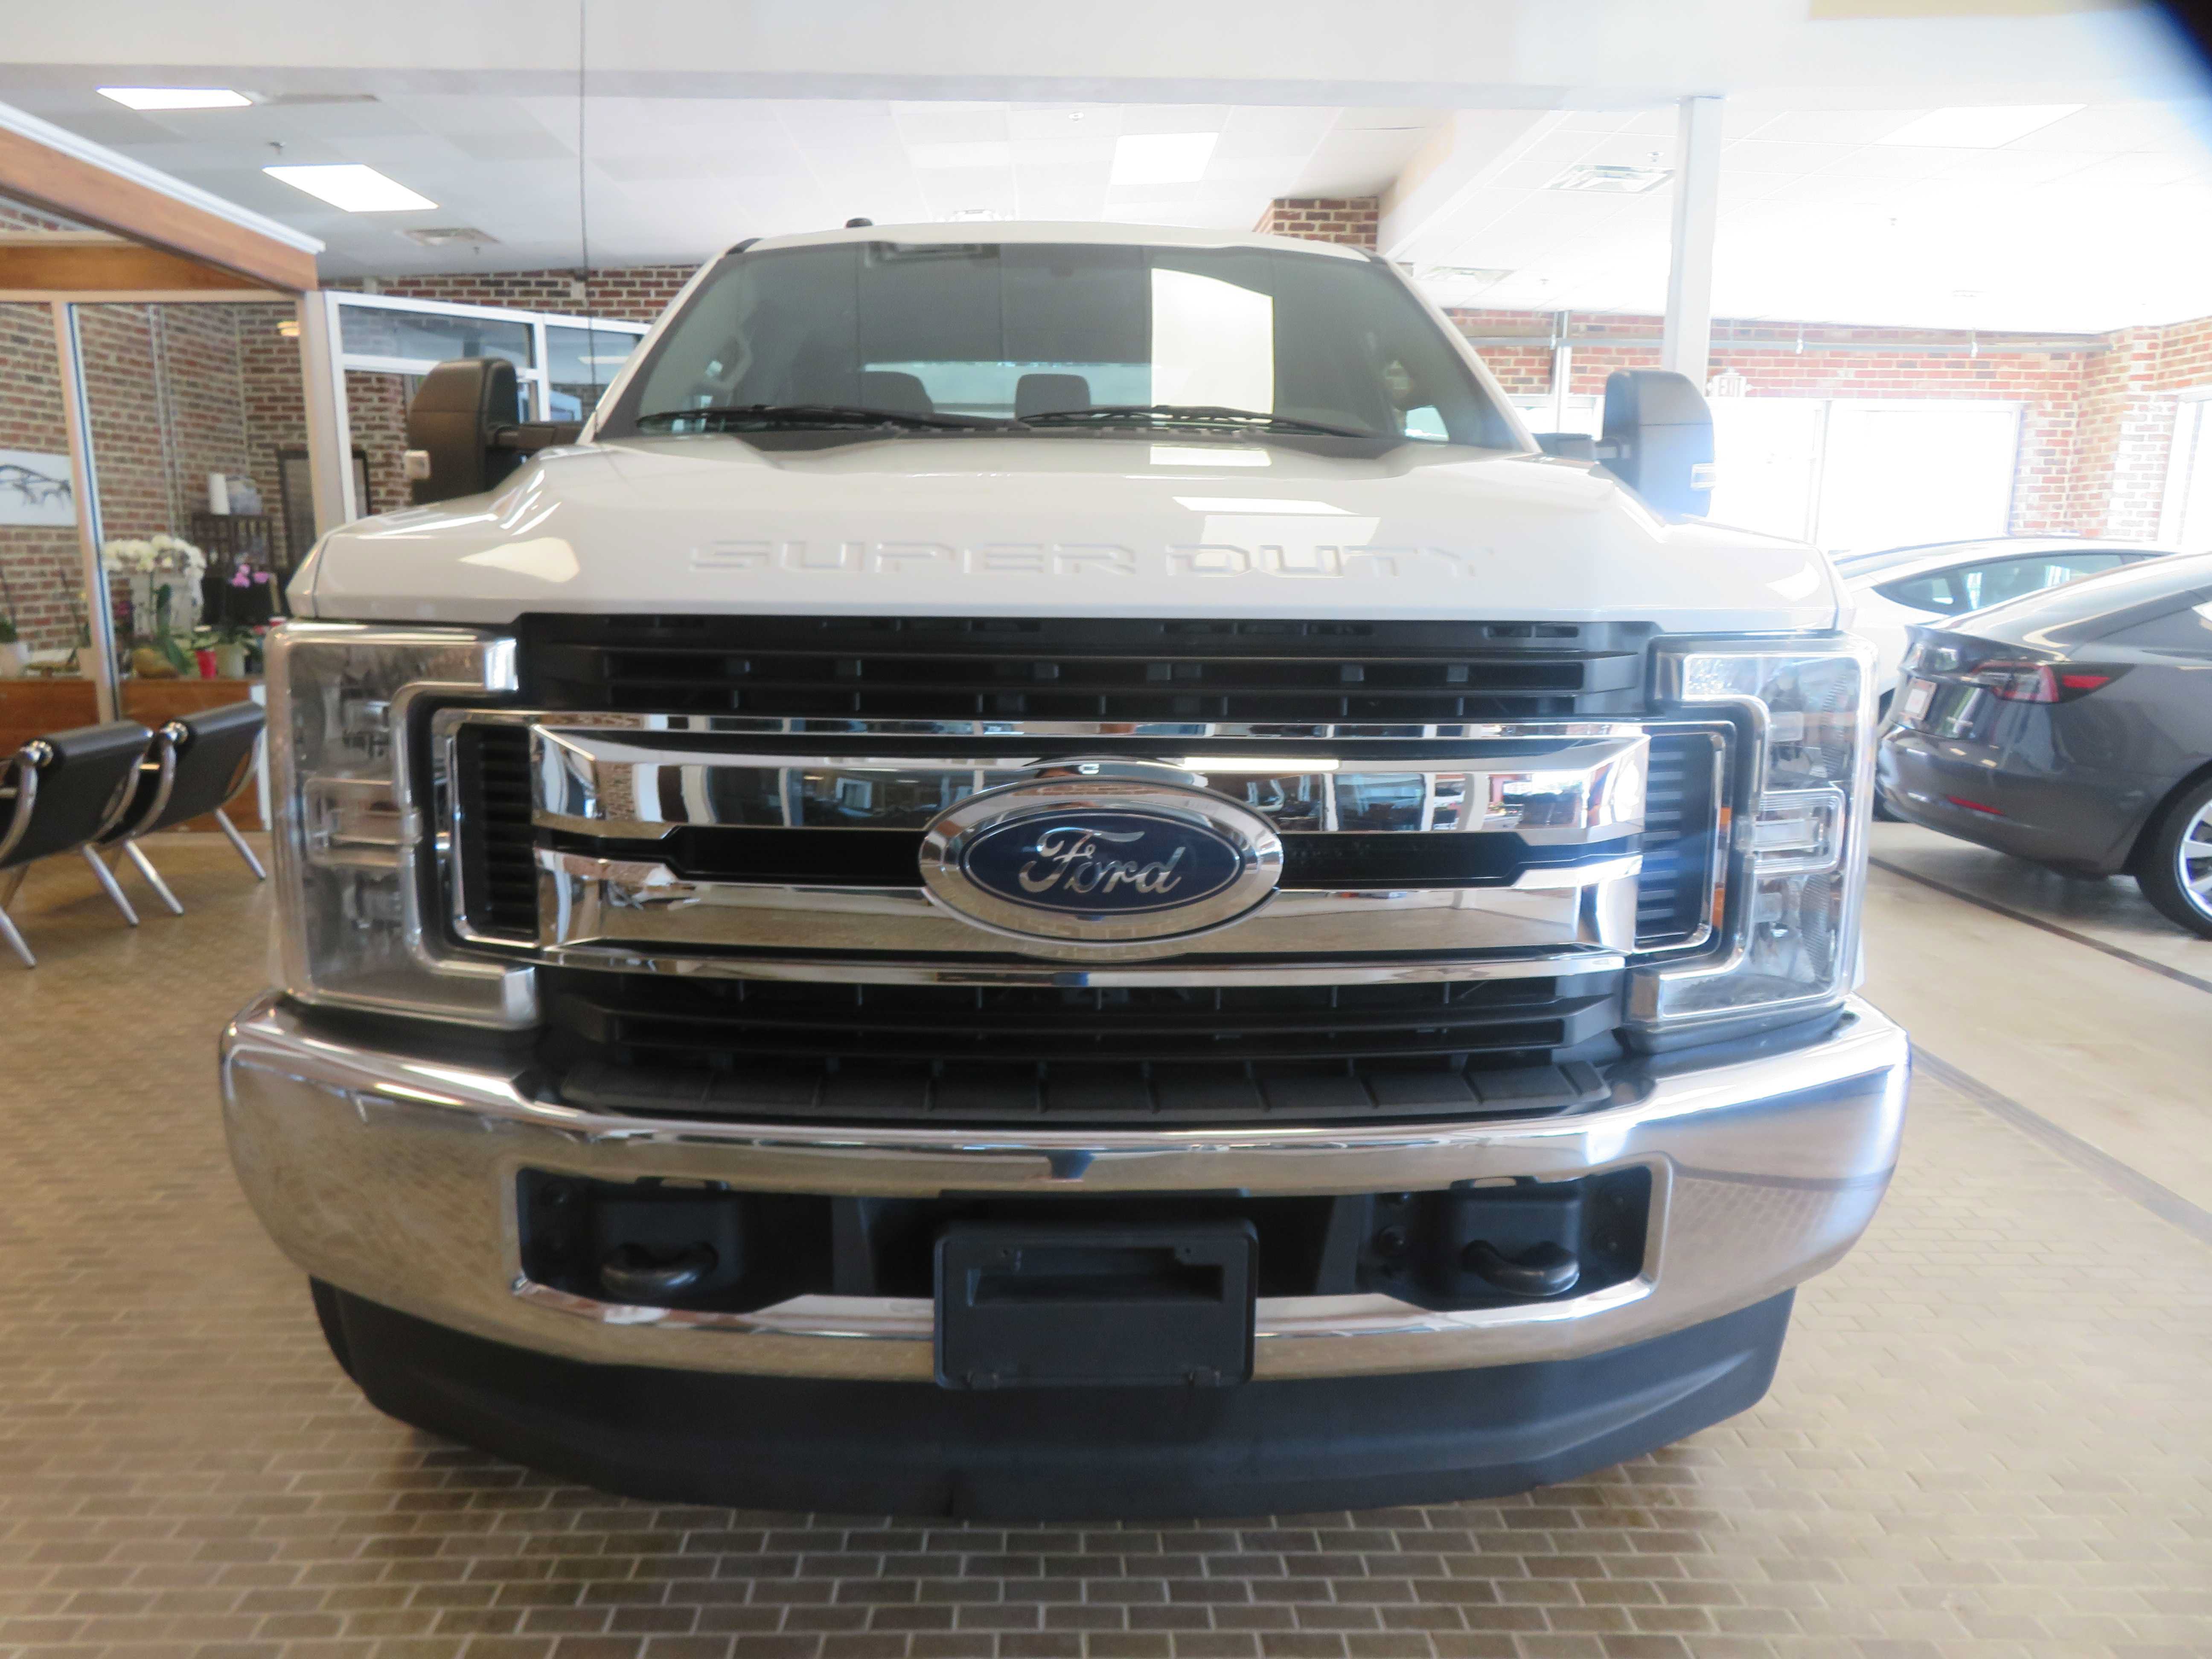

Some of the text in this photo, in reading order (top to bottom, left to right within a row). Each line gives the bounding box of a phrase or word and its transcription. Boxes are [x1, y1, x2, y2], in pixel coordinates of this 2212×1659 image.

[688, 540, 1495, 577] SUPER DUTY
[1019, 827, 1186, 894] Ford
